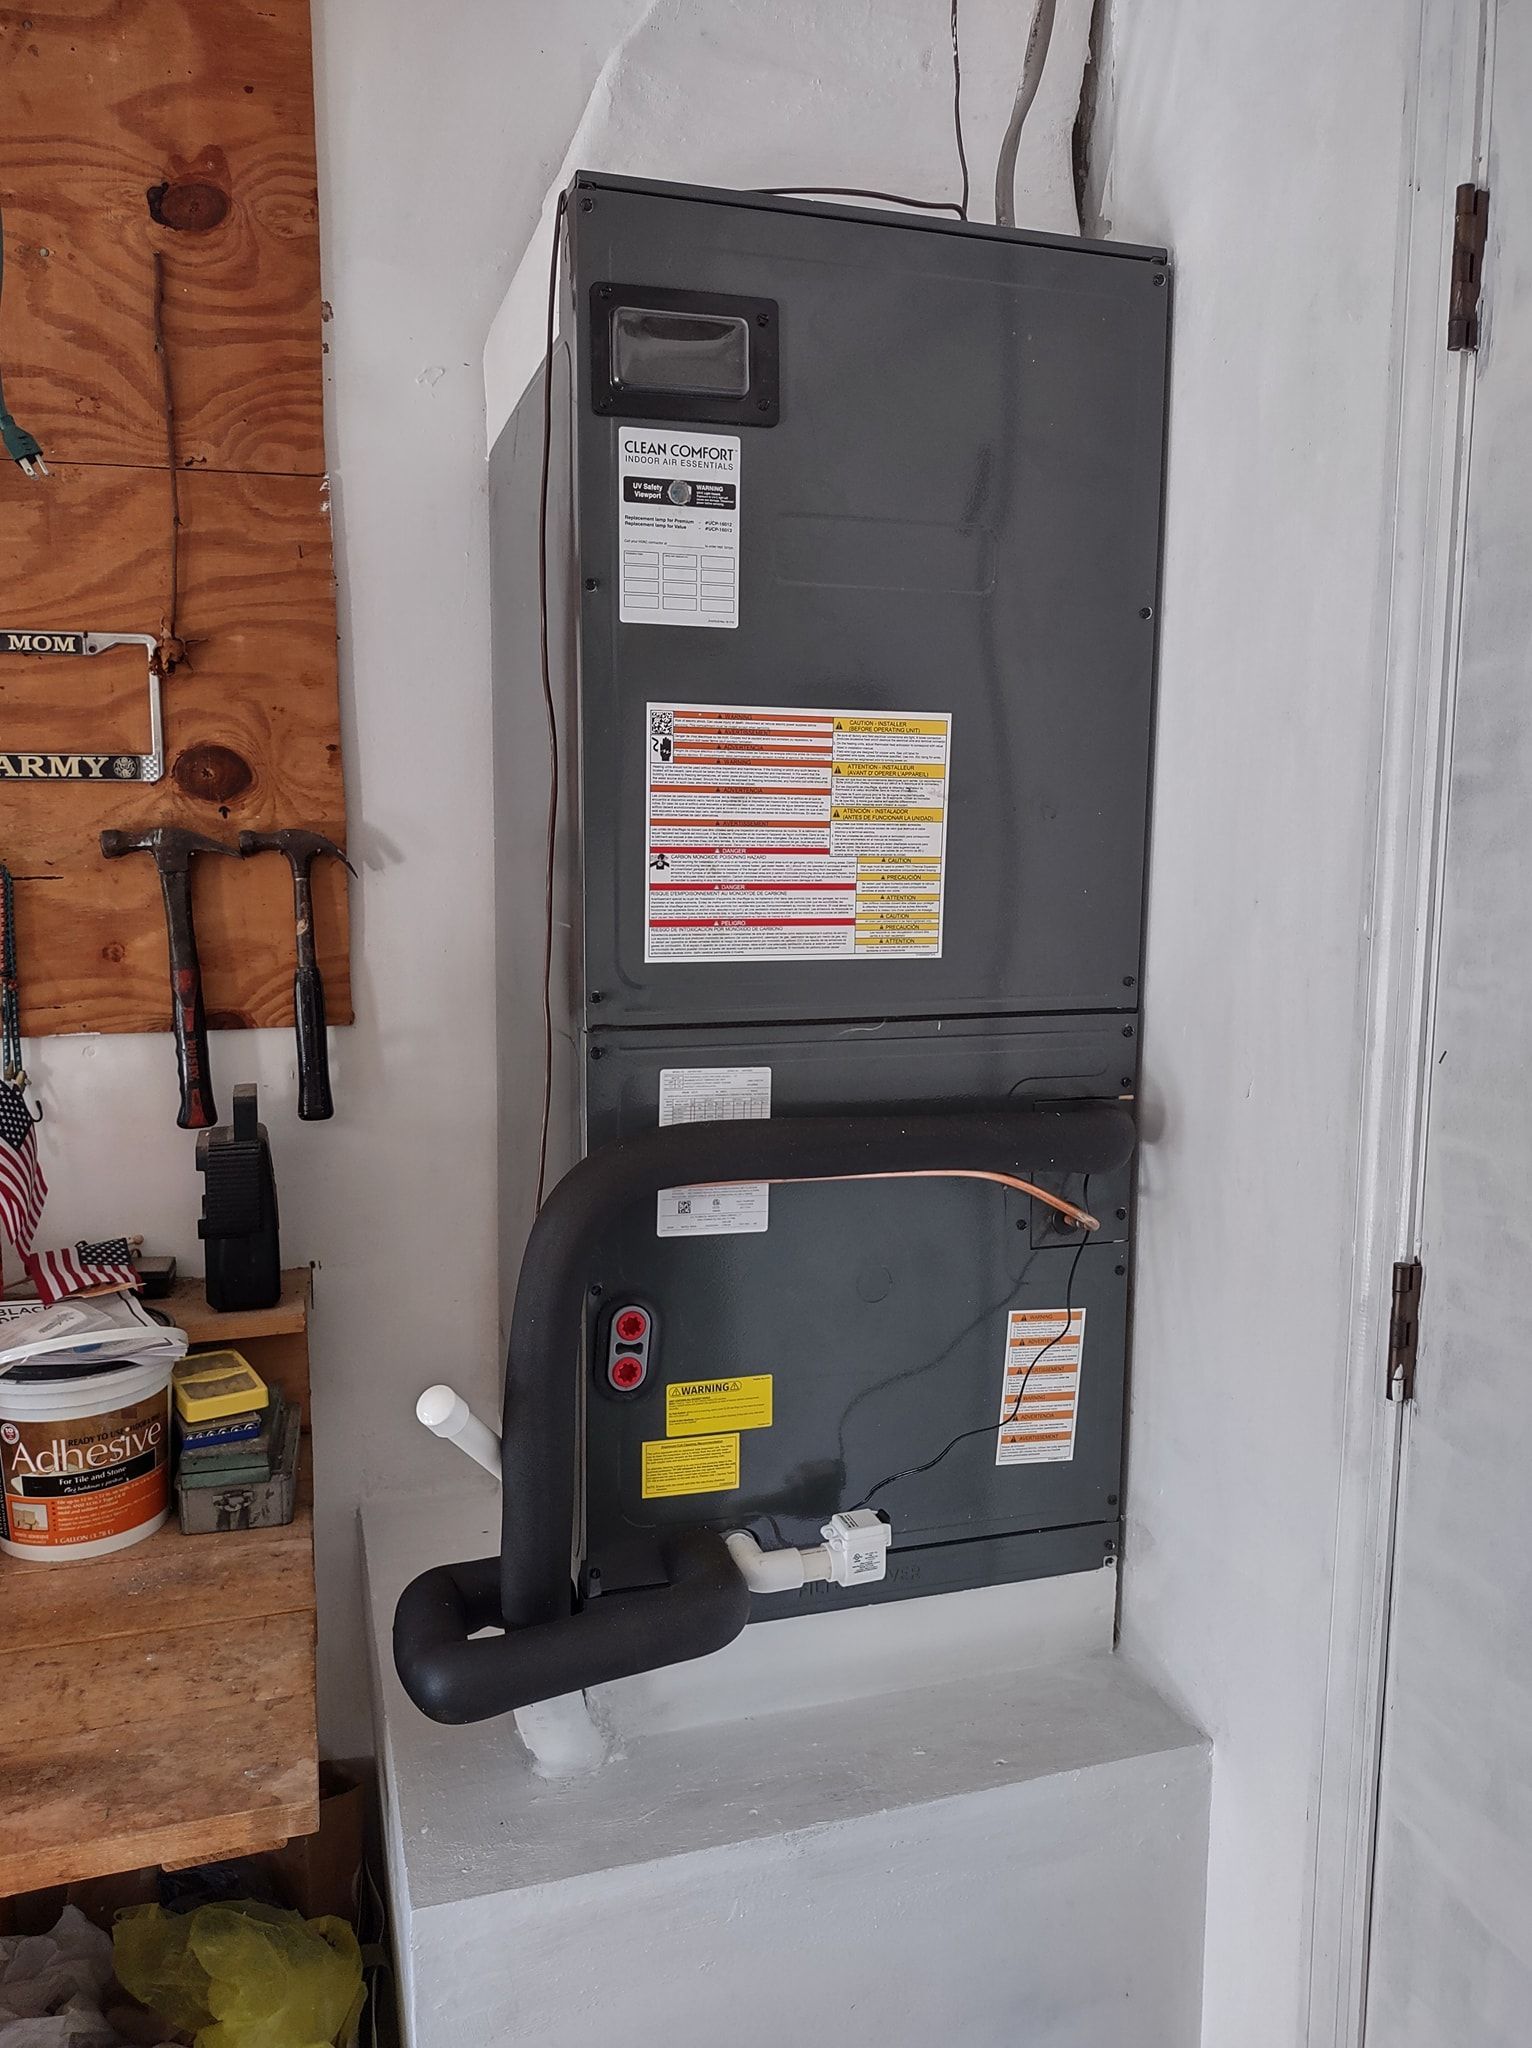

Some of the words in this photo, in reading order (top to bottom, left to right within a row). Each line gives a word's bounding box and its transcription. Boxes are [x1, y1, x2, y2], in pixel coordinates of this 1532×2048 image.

[624, 440, 667, 455] CLEAN
[670, 444, 734, 461] COMFORT
[625, 455, 660, 464] INDOOR
[662, 458, 678, 466] AIR
[680, 459, 734, 470] ESSENTIALS
[643, 483, 663, 492] Safety
[696, 484, 723, 492] WARNING
[634, 490, 662, 500] Viewport
[8, 635, 76, 652] MOM
[0, 756, 109, 777] ARMY
[681, 1382, 730, 1395] WARNING
[68, 1436, 94, 1447] READY
[97, 1433, 108, 1442] TO
[11, 1422, 161, 1473] Adhesive
[59, 1478, 72, 1486] For
[75, 1476, 89, 1484] Tile
[90, 1472, 106, 1480] and
[106, 1466, 126, 1476] Stone
[60, 1535, 89, 1544] GALLON
